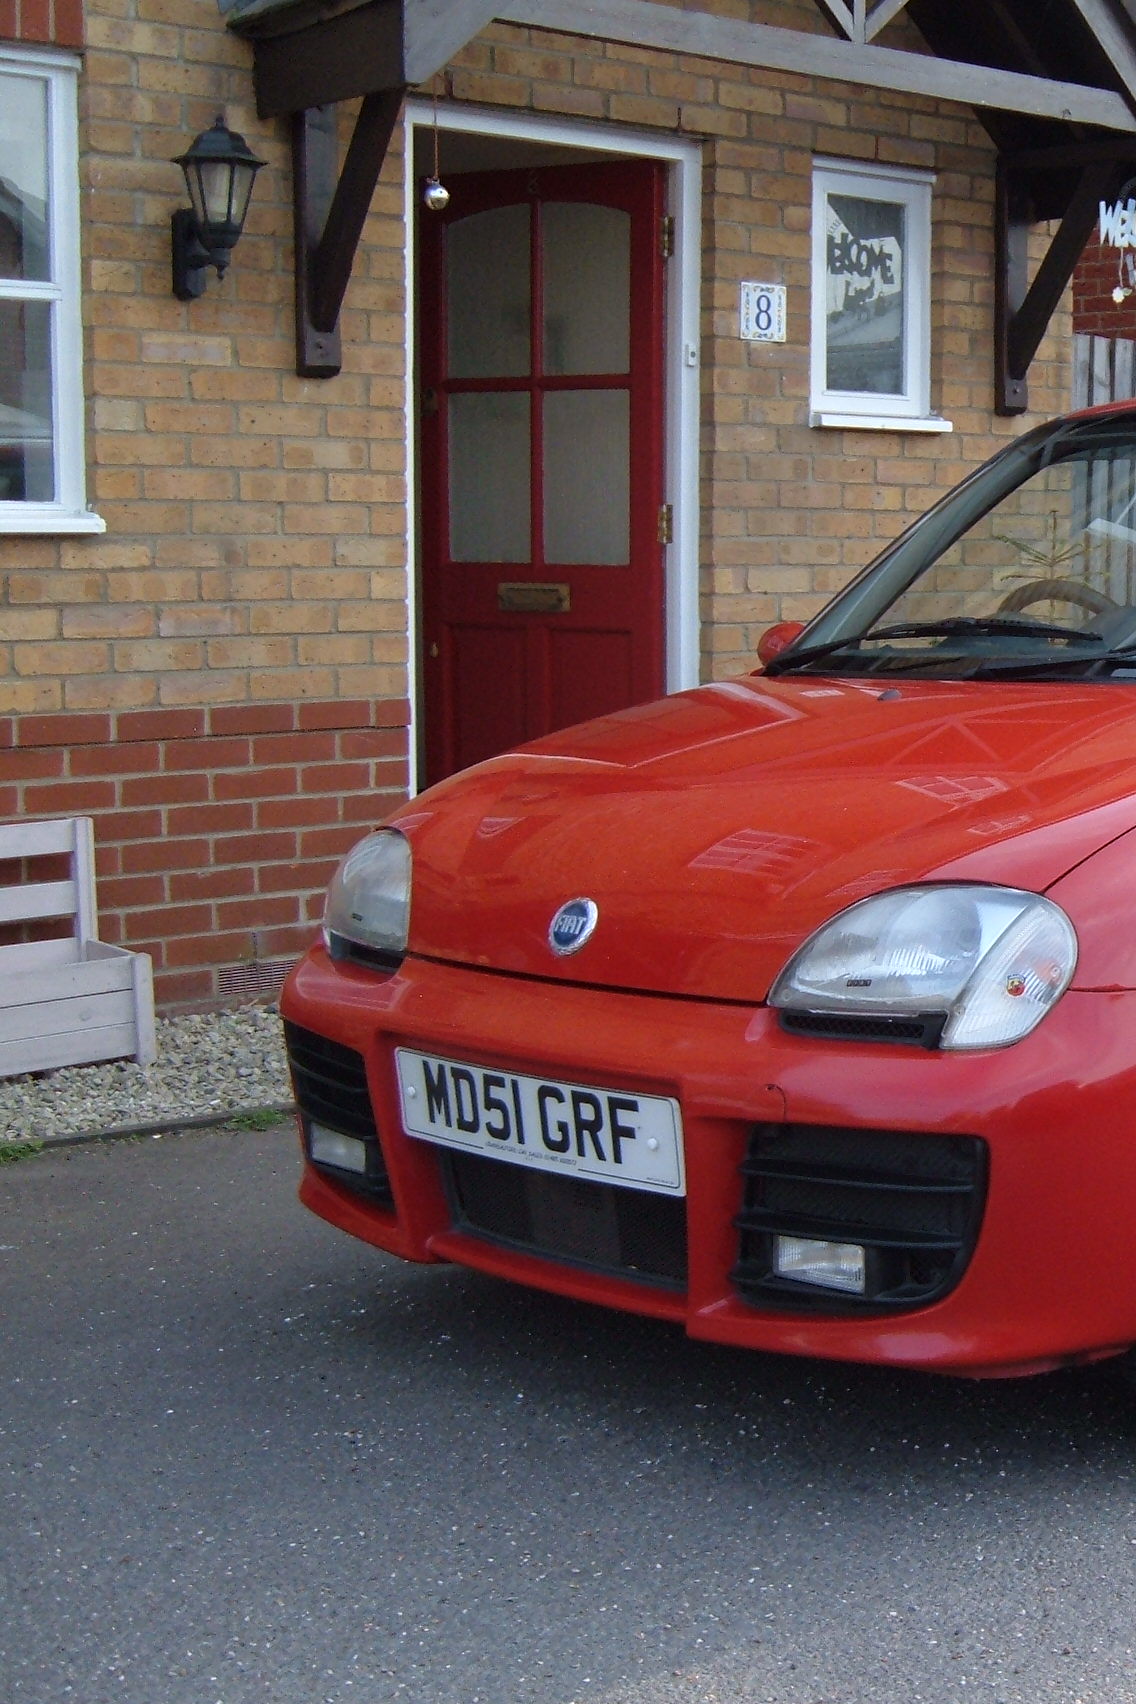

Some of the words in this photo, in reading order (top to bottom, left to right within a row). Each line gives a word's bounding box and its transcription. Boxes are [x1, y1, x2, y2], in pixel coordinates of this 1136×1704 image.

[755, 295, 771, 330] 8
[555, 915, 586, 934] FIAT
[422, 1060, 525, 1145] MD51
[537, 1084, 639, 1165] GRF
